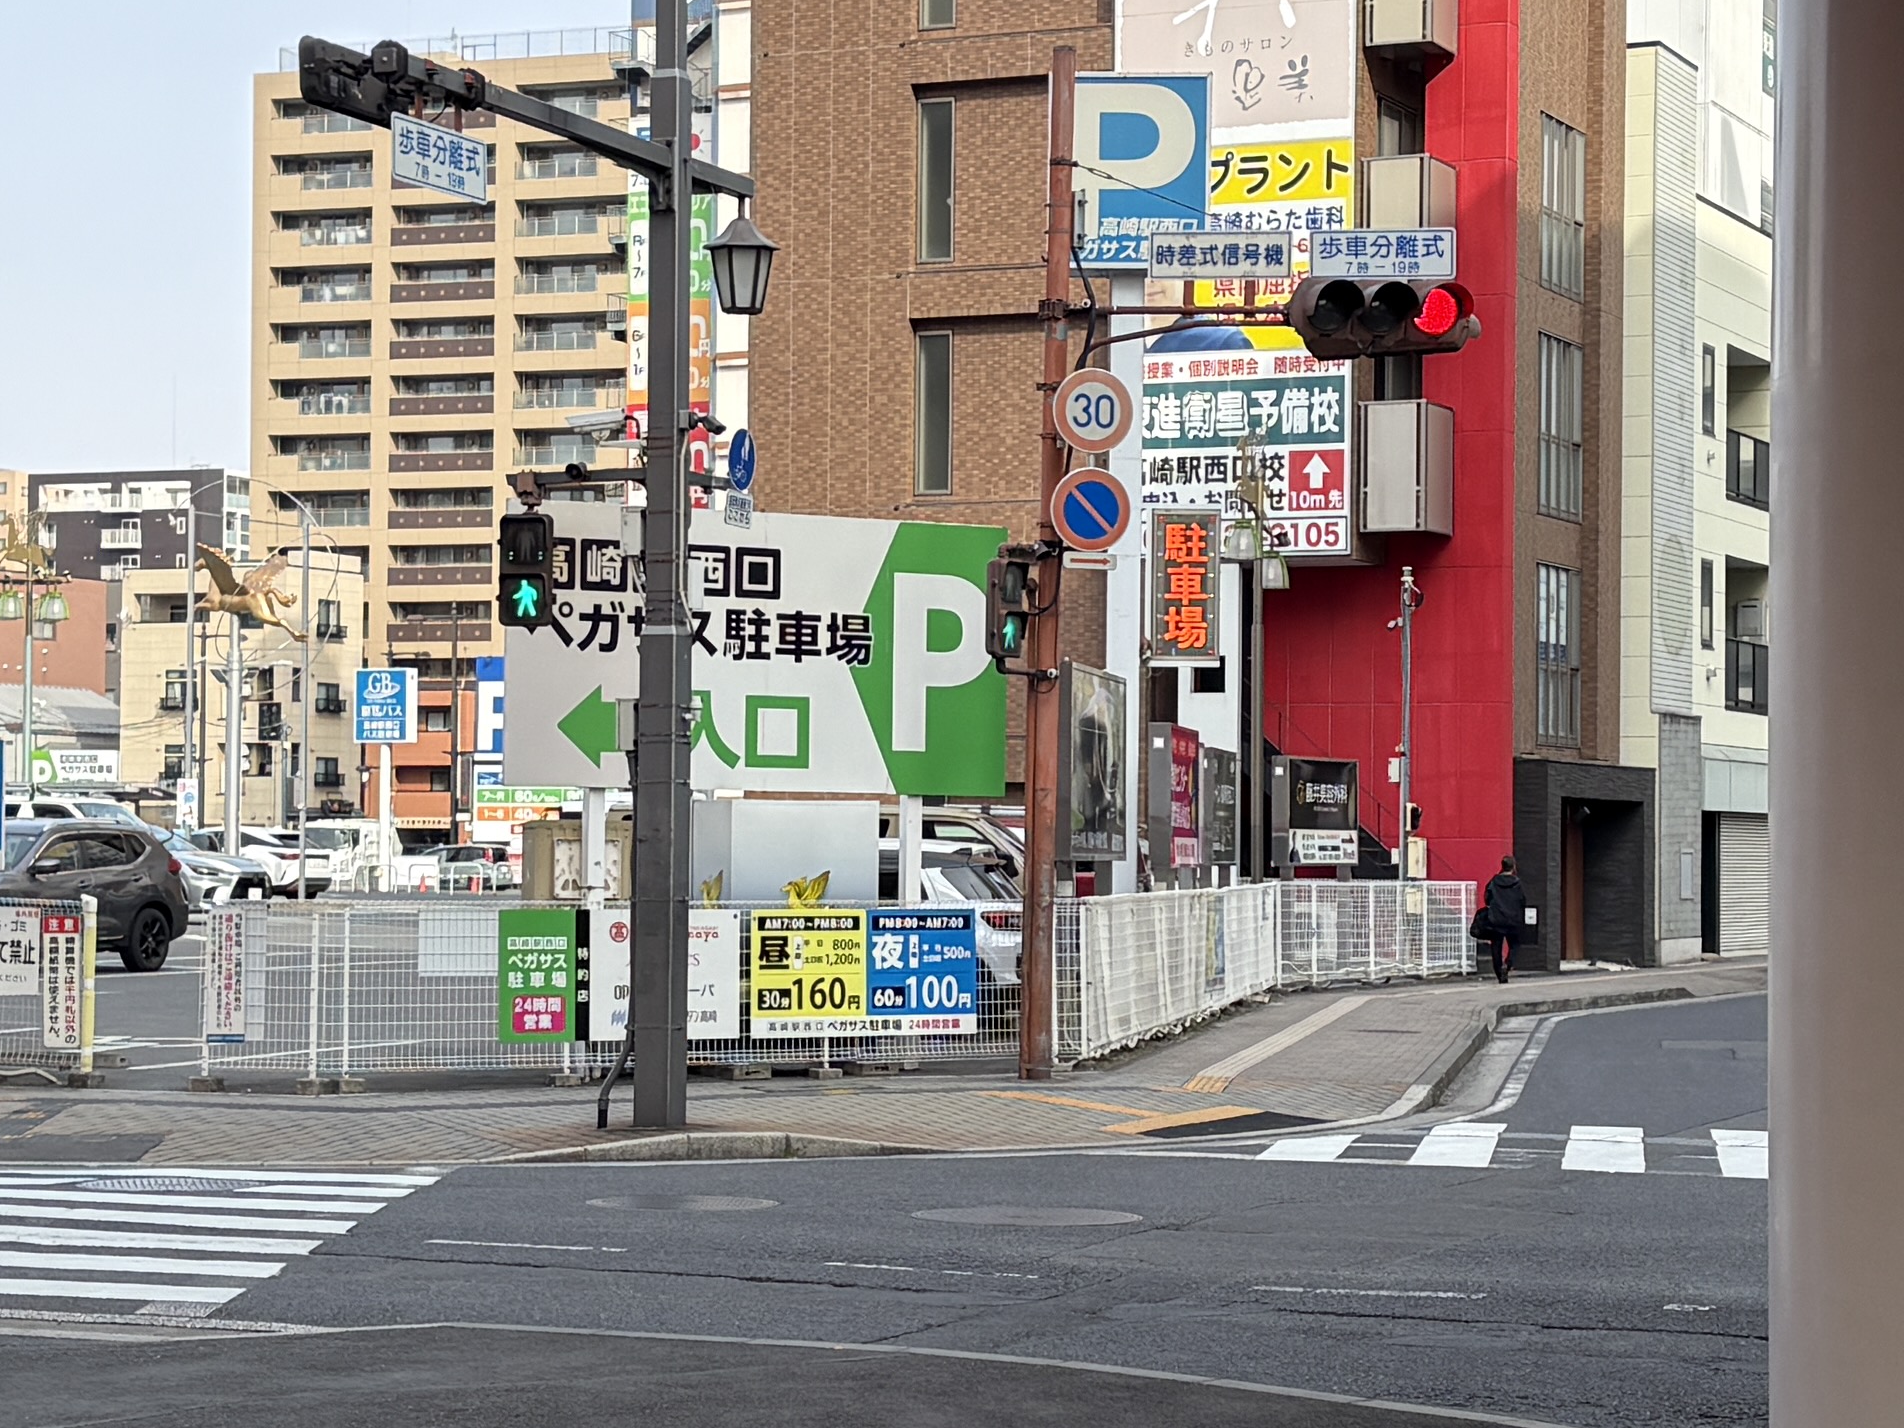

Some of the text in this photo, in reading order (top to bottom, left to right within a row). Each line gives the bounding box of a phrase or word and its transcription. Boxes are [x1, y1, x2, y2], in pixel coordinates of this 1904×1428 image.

[399, 125, 481, 177] 歩車分離式
[1156, 243, 1284, 267] 時差式信号機
[1319, 234, 1445, 260] 歩車分離式
[1072, 394, 1115, 430] 30
[1164, 523, 1209, 649] 駐車場
[892, 572, 995, 753] P
[368, 672, 392, 693] GB
[48, 918, 75, 932] 注意
[507, 953, 568, 969] ペガサス
[758, 935, 790, 970] 昼
[871, 933, 905, 970] 夜
[507, 972, 567, 988] 駐車場
[761, 977, 861, 1010] 30分 160円
[874, 975, 972, 1009] 60分 100円
[514, 998, 562, 1013] 24時間
[827, 1020, 903, 1032] ペガサス駐車場
